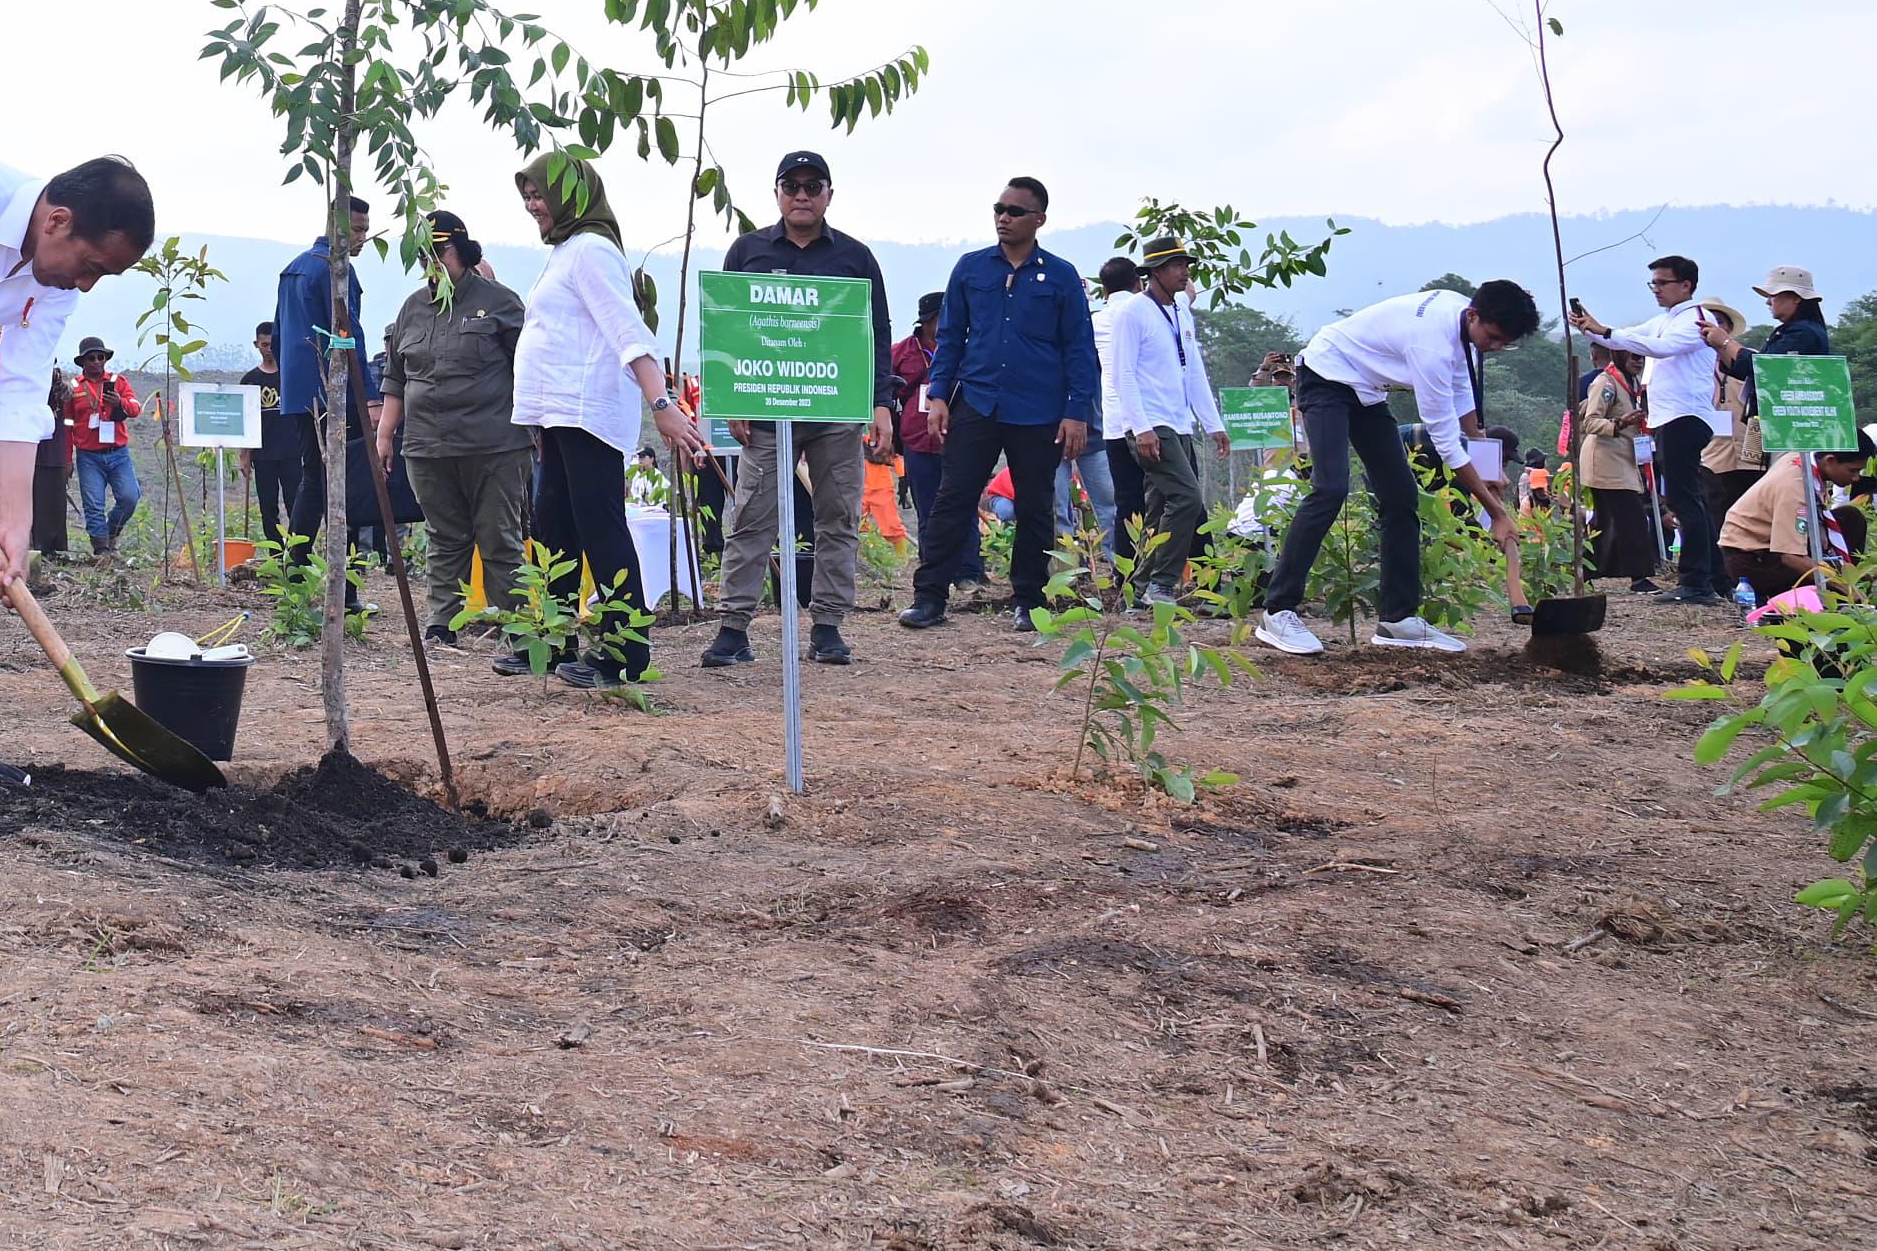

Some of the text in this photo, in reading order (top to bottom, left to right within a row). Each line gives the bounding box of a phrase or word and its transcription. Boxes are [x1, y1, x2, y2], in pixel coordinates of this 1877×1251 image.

[749, 284, 819, 306] DAMAR
[761, 336, 787, 348] Ditanam
[787, 337, 803, 348] Oleh
[734, 359, 839, 379] JOKO WIDODO
[733, 382, 839, 396] PRESIDEN REPUBLIK INDONESIA
[772, 398, 798, 407] Desember
